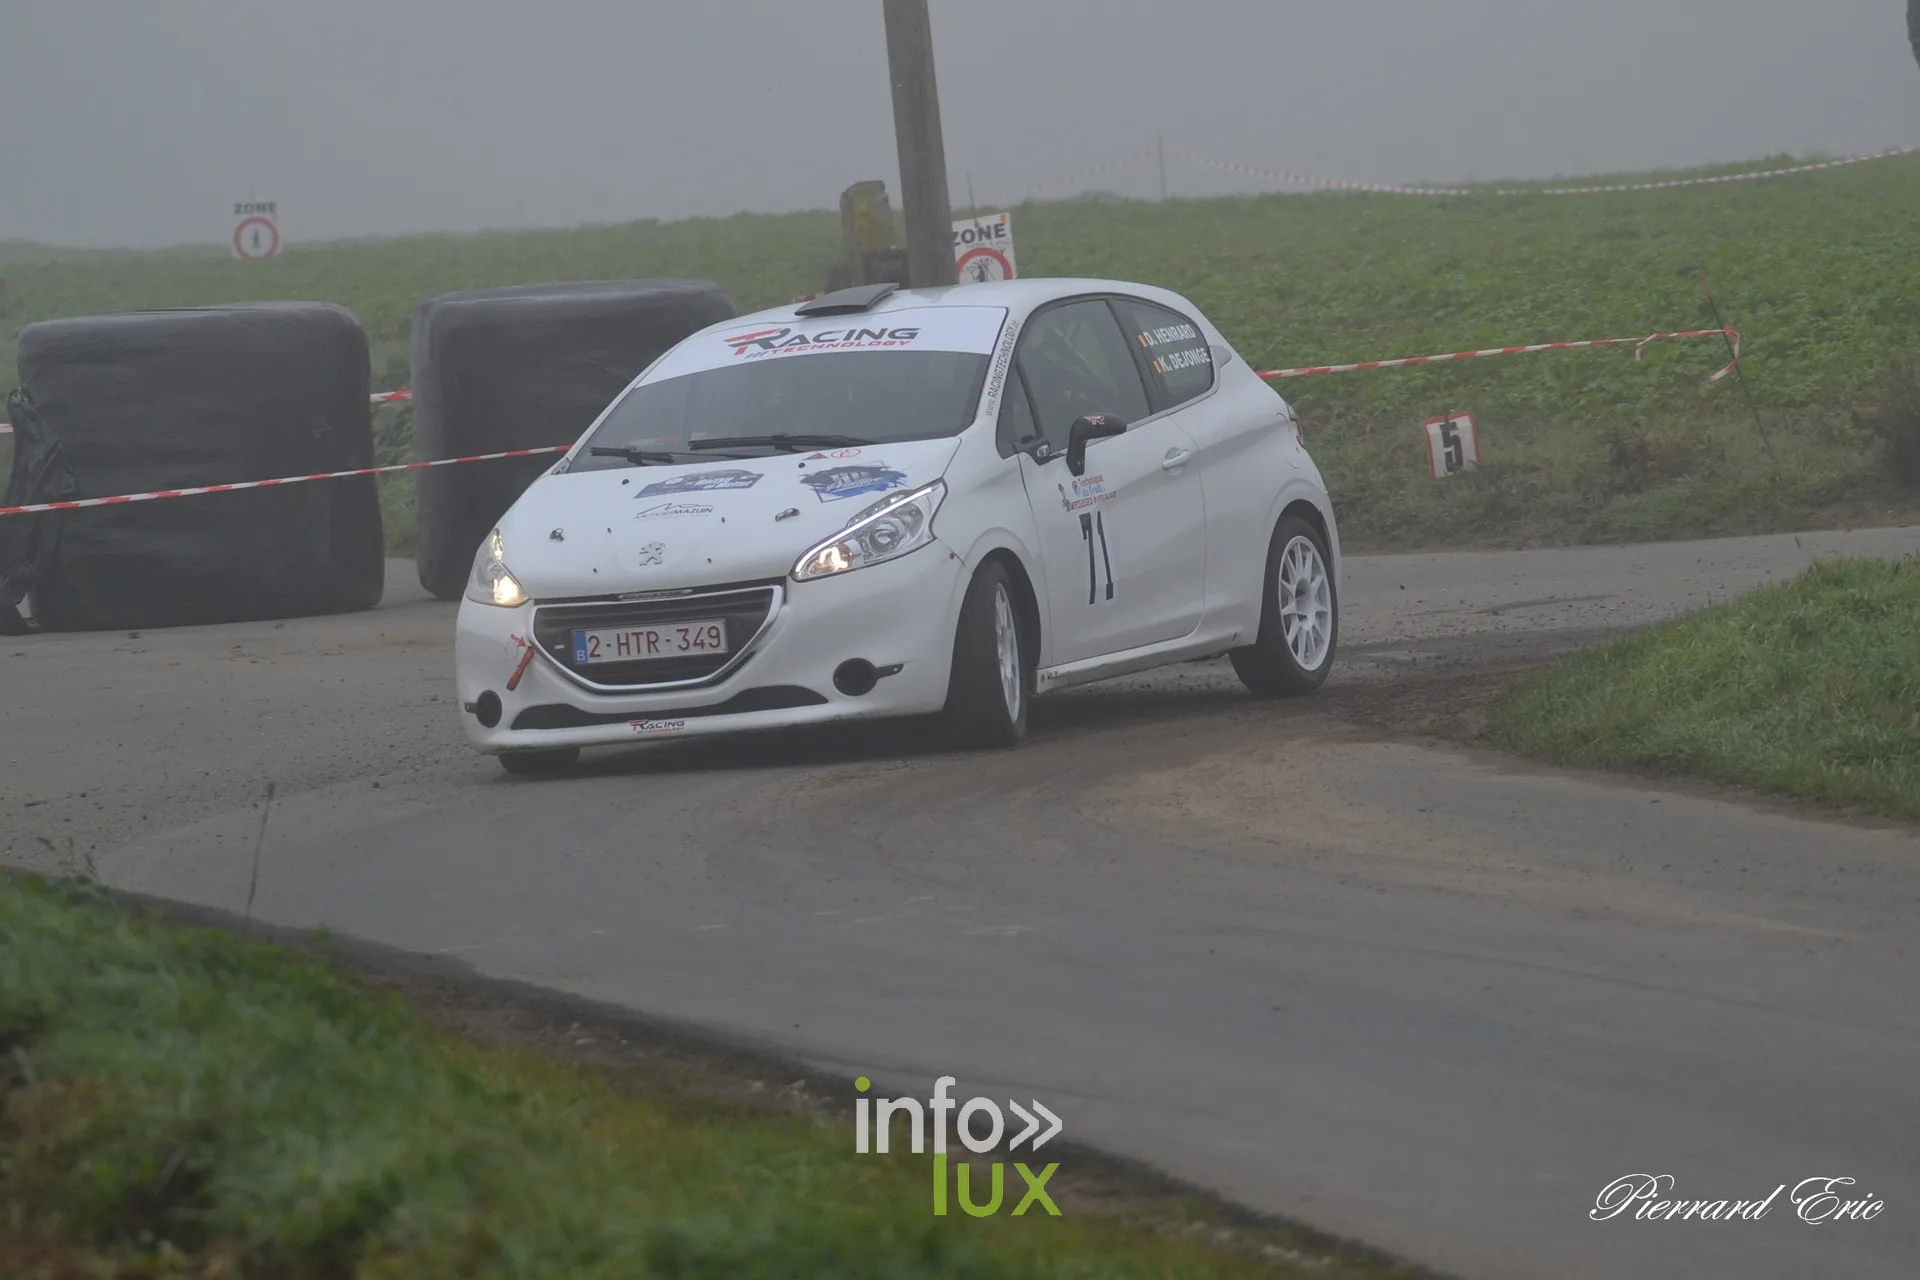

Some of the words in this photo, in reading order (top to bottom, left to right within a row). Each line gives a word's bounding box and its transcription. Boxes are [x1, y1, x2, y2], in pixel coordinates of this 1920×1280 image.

[233, 202, 278, 215] ZONE
[953, 223, 1007, 246] ZONE
[724, 328, 922, 355] RACING
[1142, 331, 1158, 346] D.
[1153, 324, 1197, 344] HENRARD
[772, 340, 912, 355] TECHNOLOGY
[1157, 355, 1173, 372] K.
[1168, 347, 1211, 370] DEJONGE
[1439, 421, 1464, 474] 5
[1078, 510, 1114, 605] 71
[587, 625, 721, 659] 2-HTR-349
[577, 650, 586, 662] B
[628, 719, 686, 732] RACING
